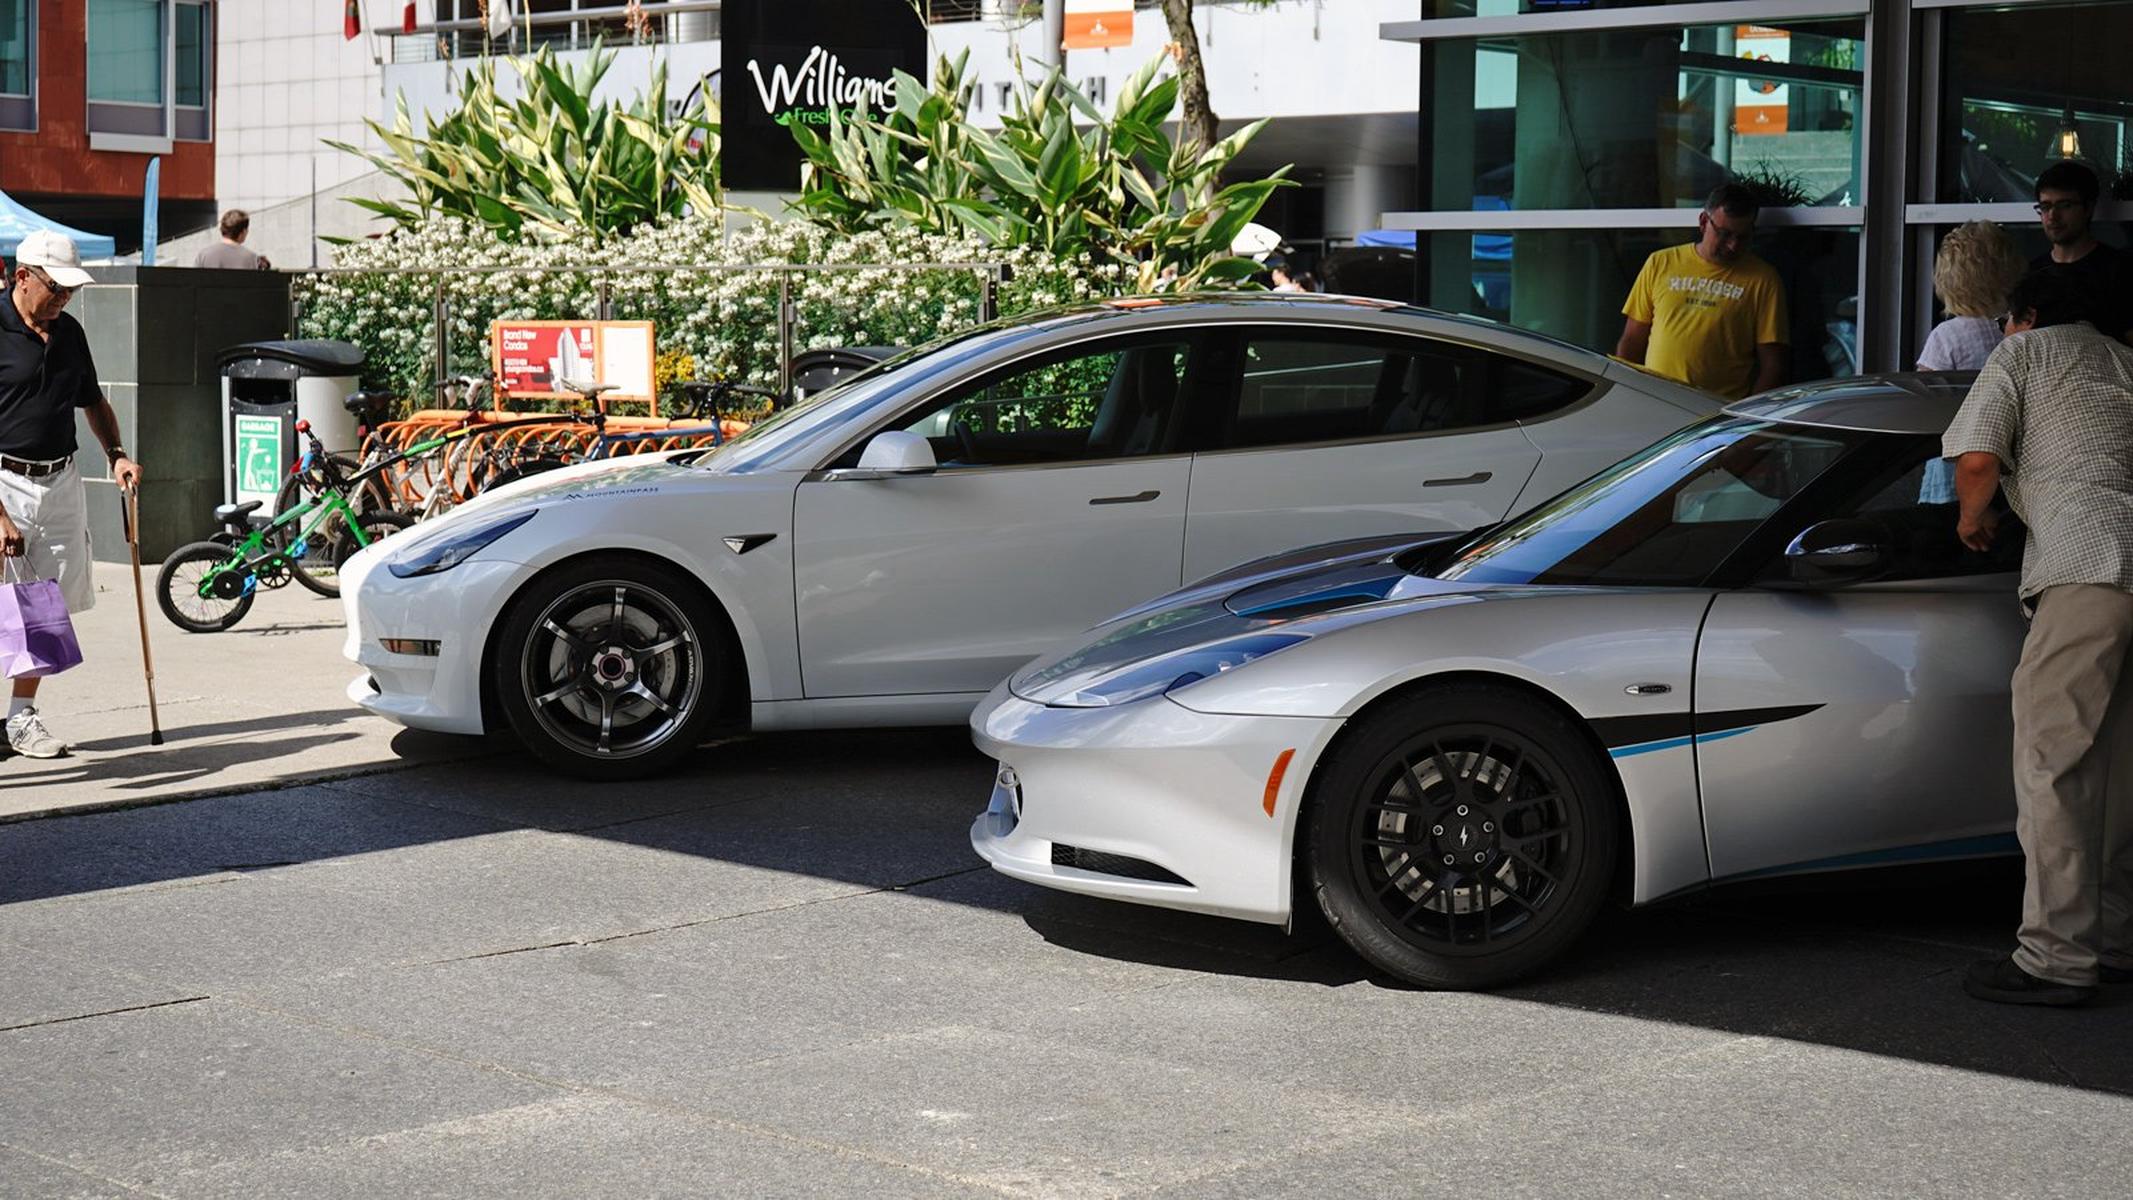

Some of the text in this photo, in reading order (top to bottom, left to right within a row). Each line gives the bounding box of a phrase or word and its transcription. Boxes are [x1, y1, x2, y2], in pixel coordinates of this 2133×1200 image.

[746, 45, 898, 114] Williams
[522, 330, 537, 340] New
[503, 340, 529, 351] Condos
